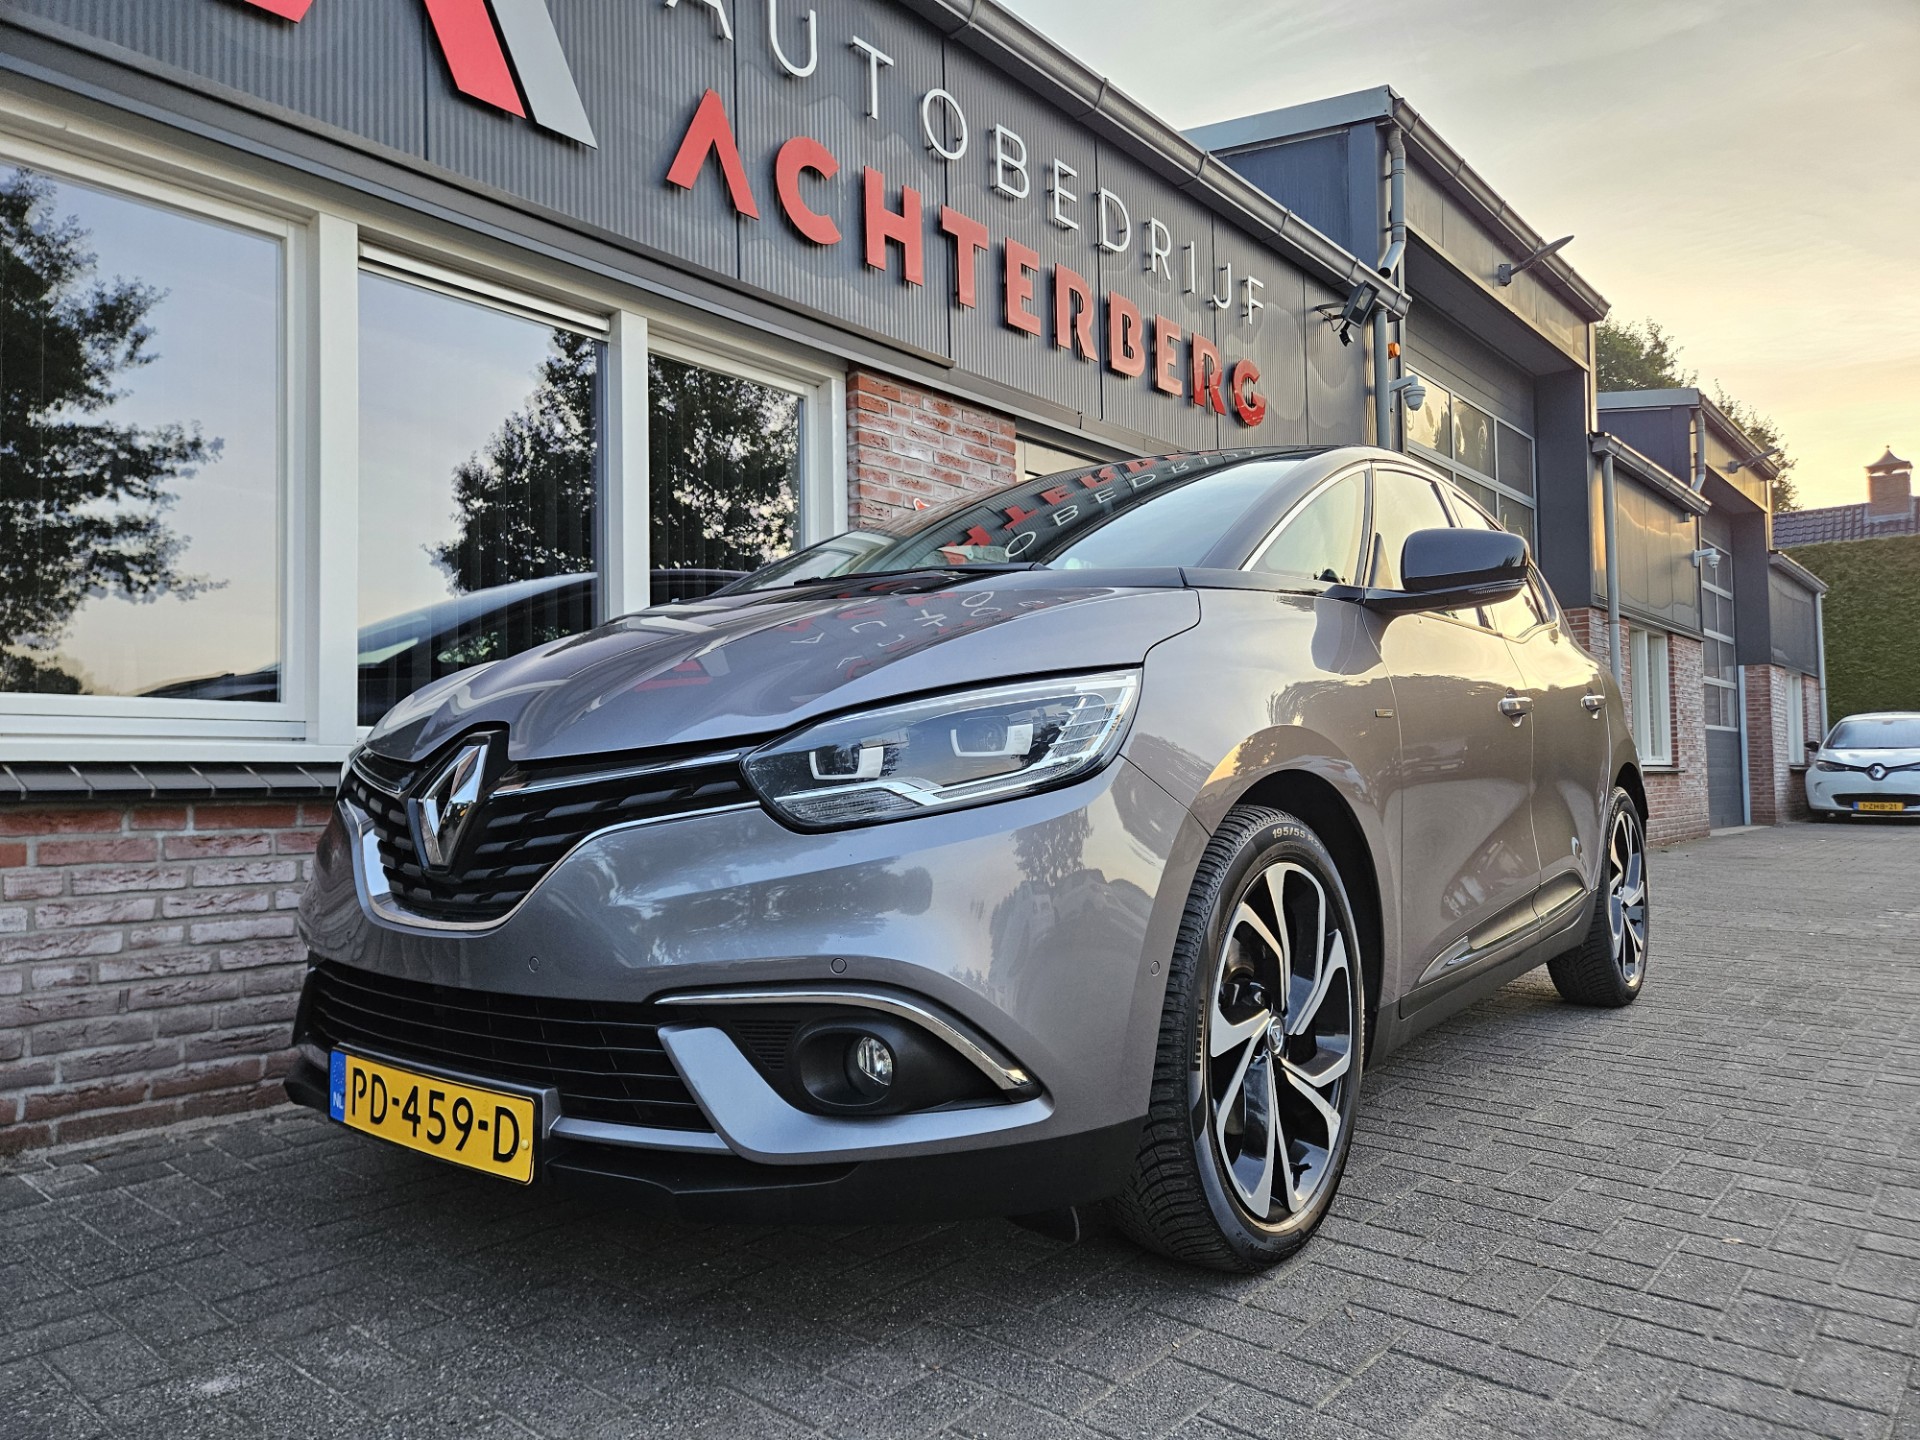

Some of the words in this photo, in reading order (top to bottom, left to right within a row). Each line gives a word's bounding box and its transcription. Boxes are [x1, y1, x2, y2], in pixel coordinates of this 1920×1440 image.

[667, 88, 1266, 427] ACHTERBERG
[1272, 826, 1306, 839] 195/55
[333, 1091, 344, 1110] NL
[351, 1067, 520, 1163] PD-459-D
